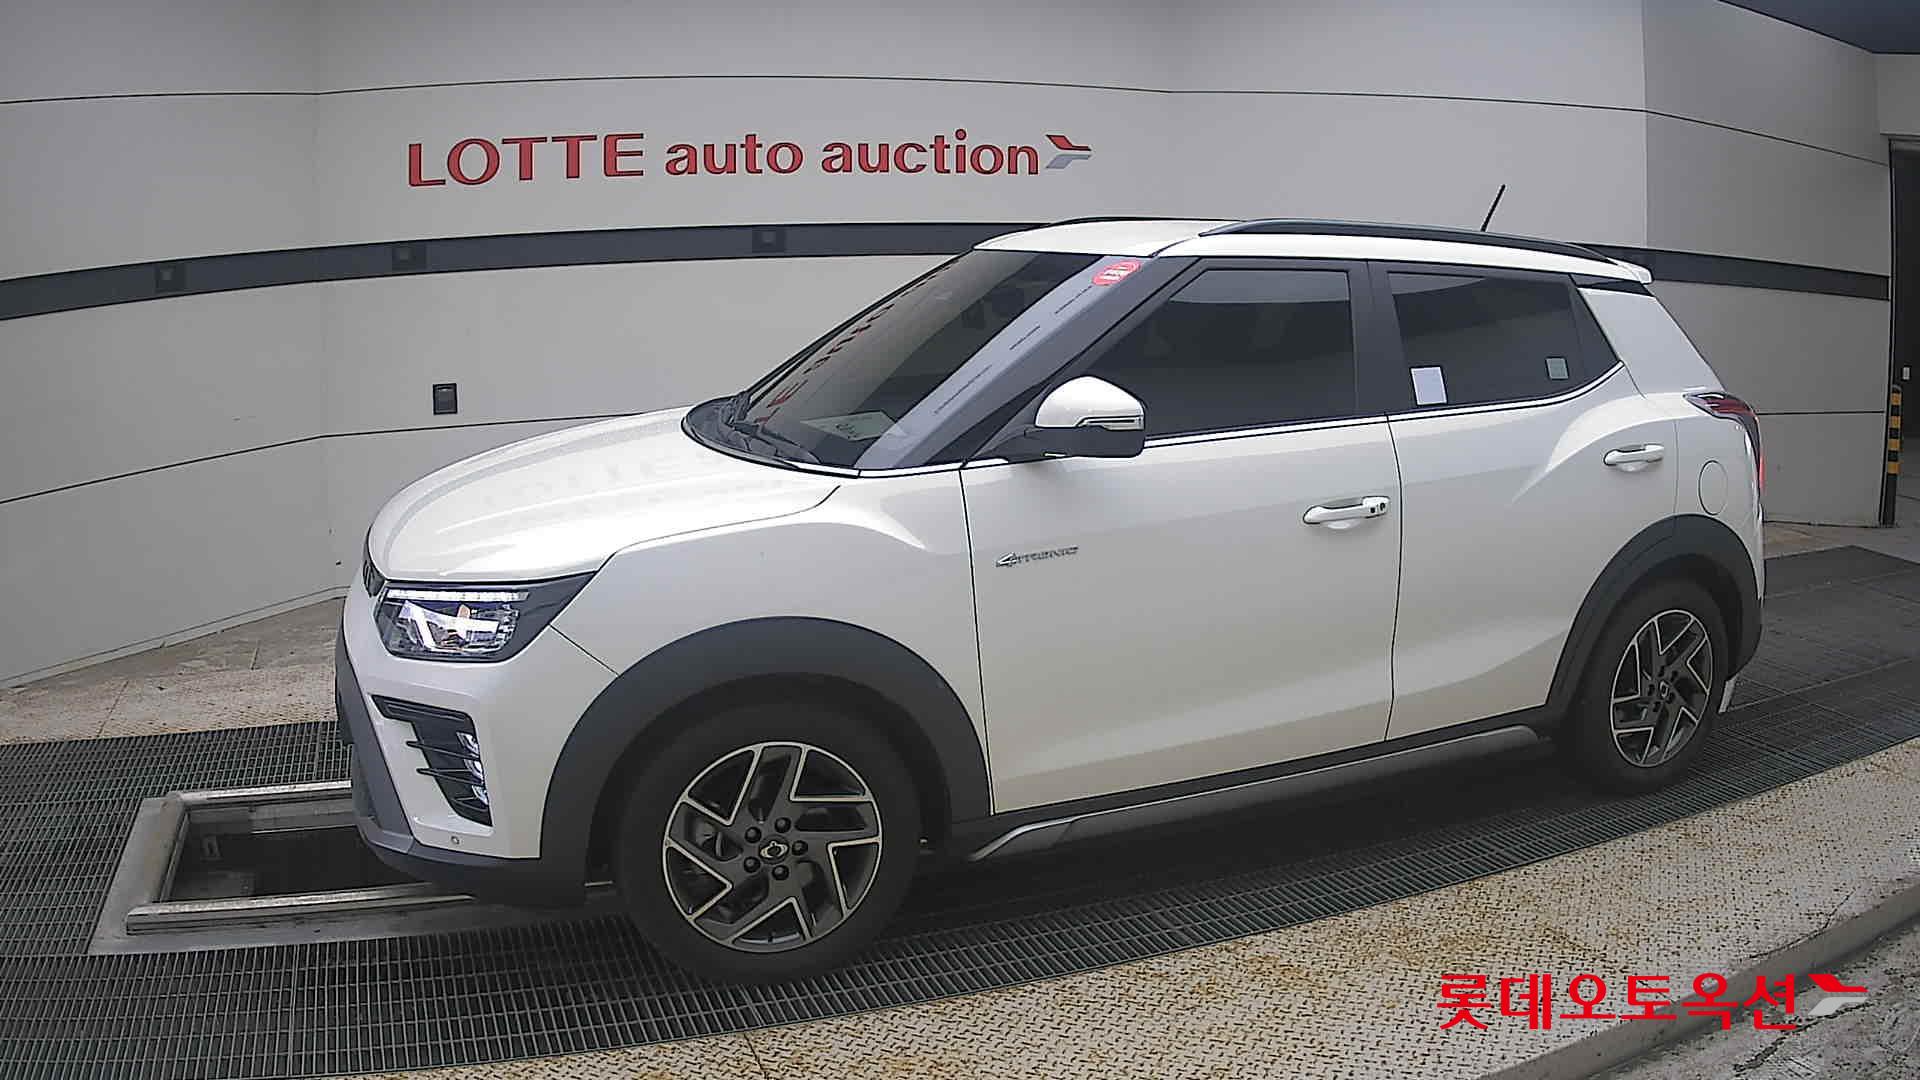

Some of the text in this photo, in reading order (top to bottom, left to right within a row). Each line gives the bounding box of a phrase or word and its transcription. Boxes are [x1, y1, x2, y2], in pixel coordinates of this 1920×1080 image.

[408, 128, 1039, 187] LOTTE auto auction
